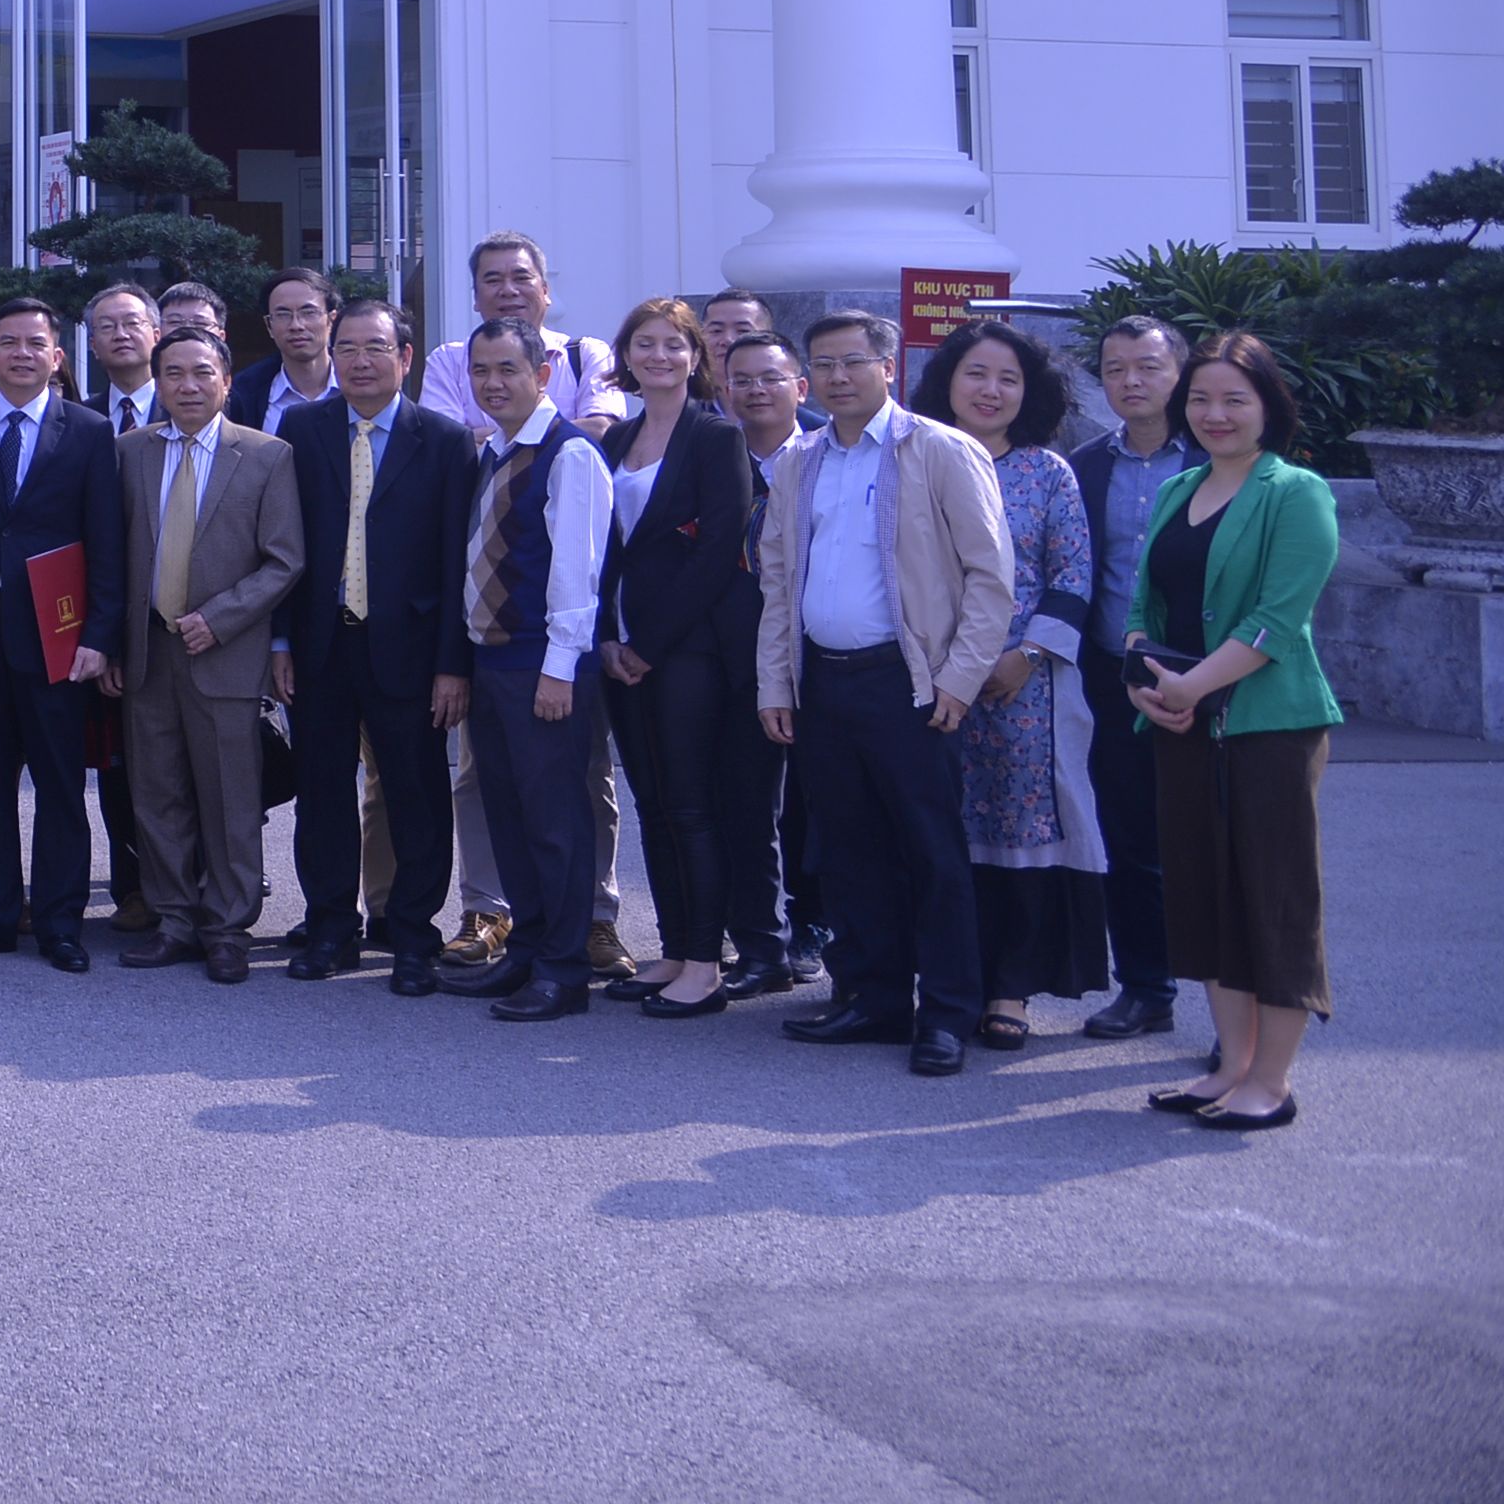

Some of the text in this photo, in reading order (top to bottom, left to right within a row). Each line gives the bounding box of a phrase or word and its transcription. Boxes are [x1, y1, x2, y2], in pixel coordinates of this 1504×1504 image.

[913, 281, 994, 300] KHU VỰC THI
